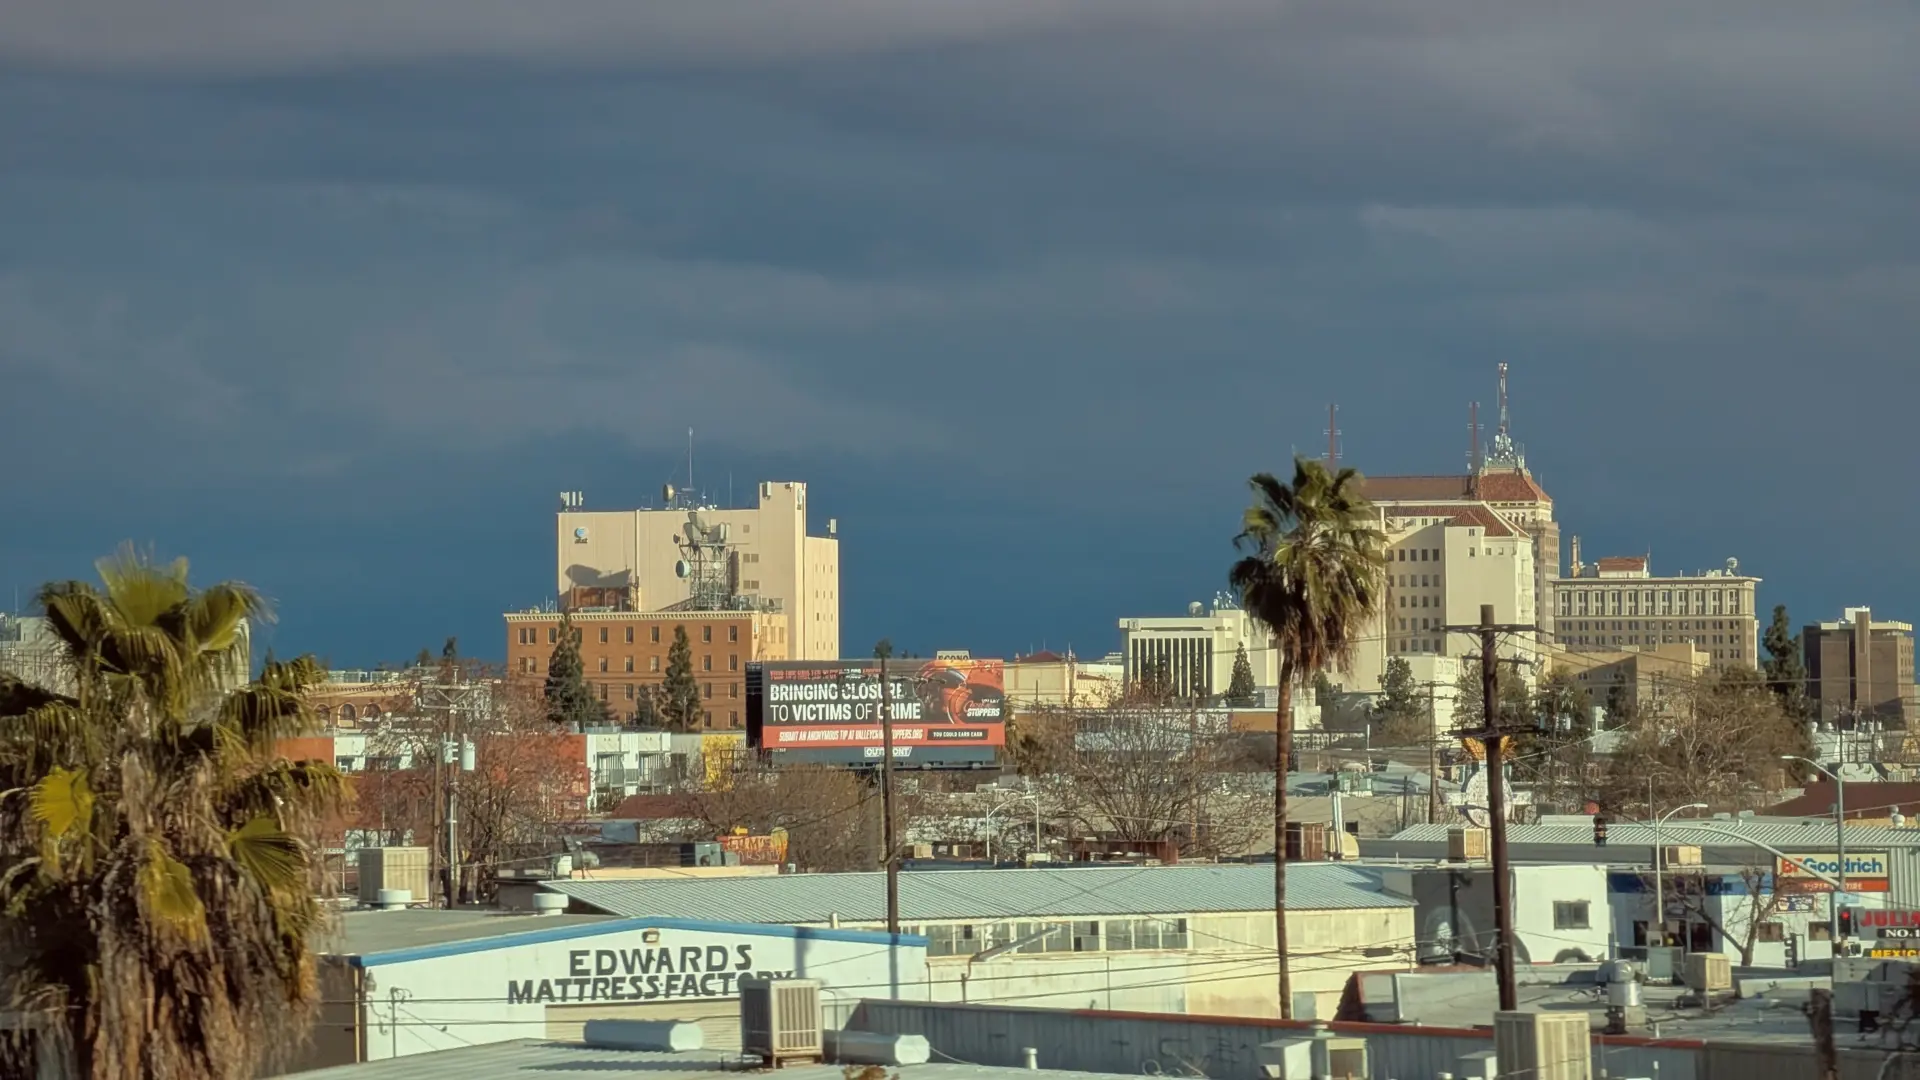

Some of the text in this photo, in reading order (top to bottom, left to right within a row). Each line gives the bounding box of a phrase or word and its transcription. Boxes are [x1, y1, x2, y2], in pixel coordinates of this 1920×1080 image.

[770, 683, 838, 701] BRINGING
[770, 703, 789, 721] TO
[792, 703, 851, 721] VICTIMS
[855, 703, 873, 720] OF
[967, 708, 1000, 717] STOPPERS
[779, 730, 799, 742] SUBMIT
[799, 730, 807, 741] AN
[807, 730, 839, 741] ANONYMOUS
[839, 730, 848, 740] TIP
[848, 729, 856, 740] AT
[569, 944, 753, 977] EDWARDS
[1871, 949, 1920, 959] MEXIC
[508, 975, 660, 1004] MATTRESS
